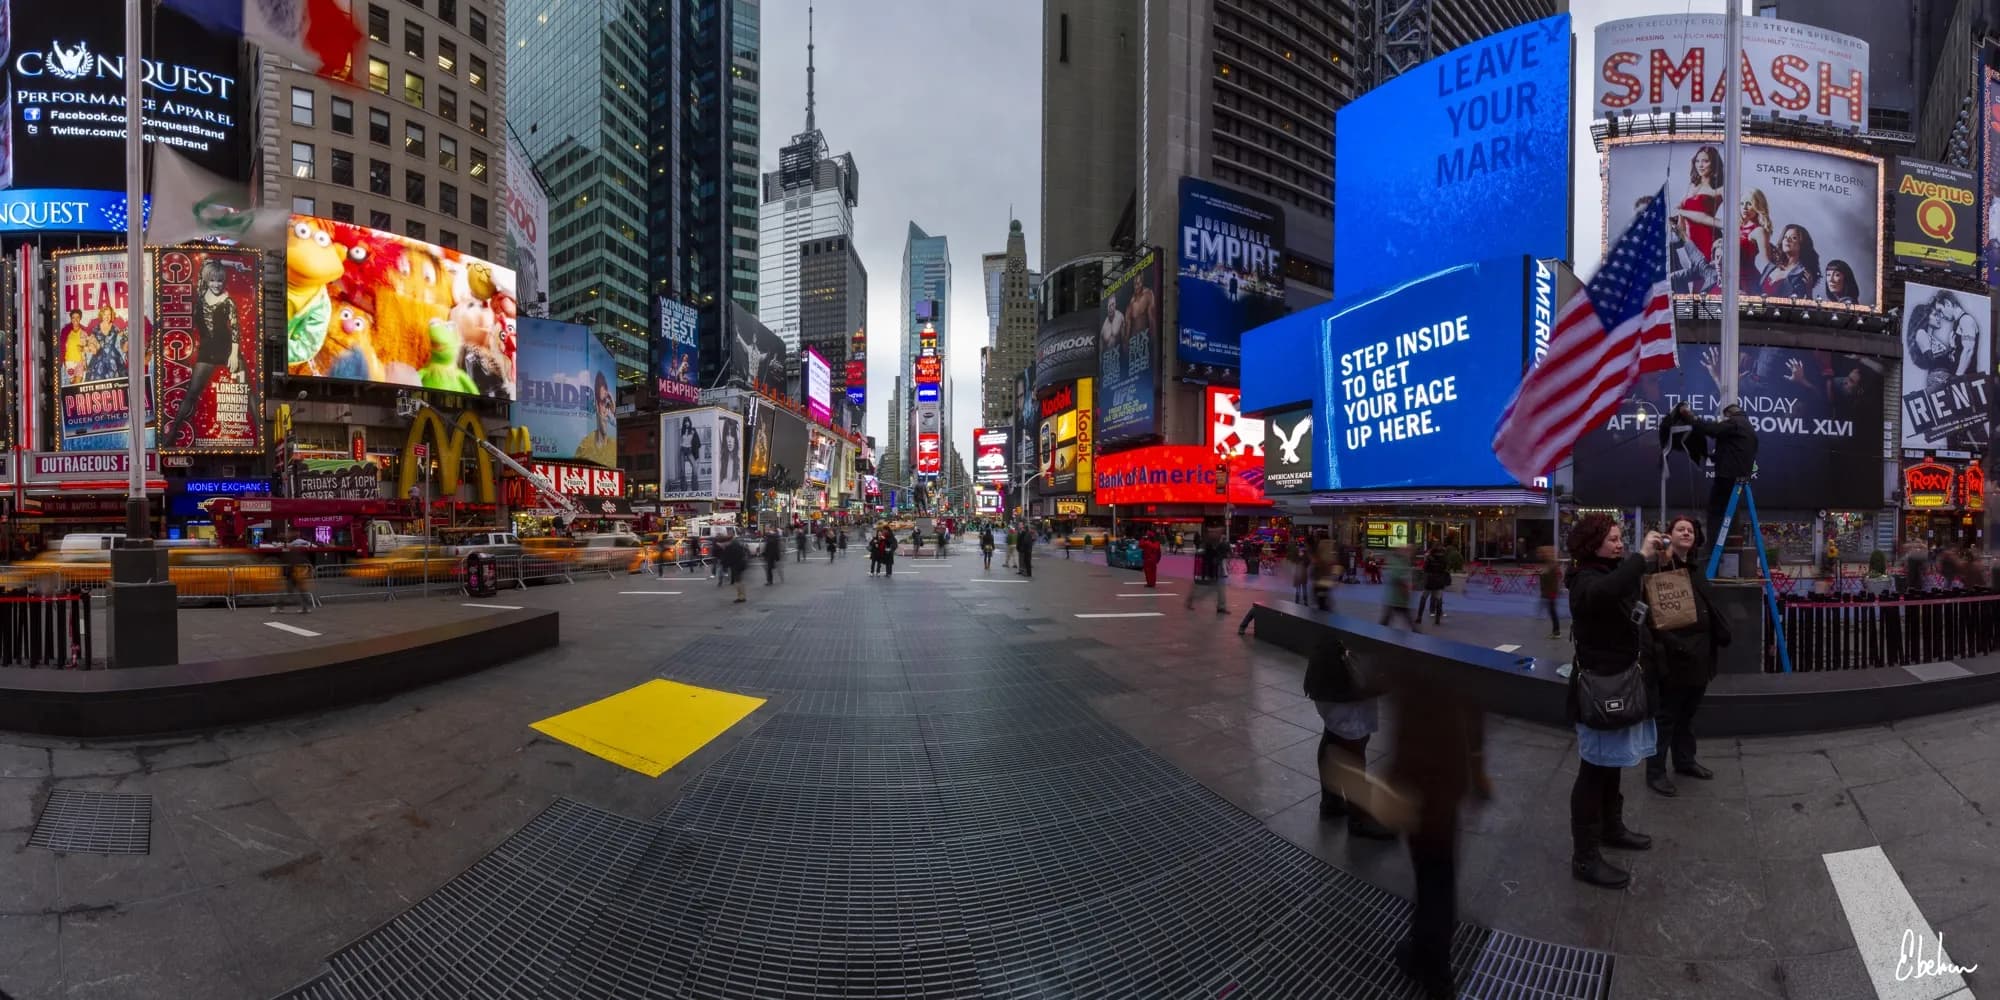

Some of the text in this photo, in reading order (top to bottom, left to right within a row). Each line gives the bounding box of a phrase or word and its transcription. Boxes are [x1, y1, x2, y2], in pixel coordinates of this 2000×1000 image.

[1638, 18, 1698, 28] EXECUTIVE
[1702, 18, 1759, 28] PROER
[1763, 22, 1804, 36] STEVEN
[1807, 31, 1864, 49] SPIELBERG
[1438, 31, 1540, 98] LEAVE
[1601, 47, 1862, 122] SMASH
[163, 101, 234, 127] APPAREL
[1447, 81, 1538, 138] YOUR
[1436, 129, 1538, 188] MARK
[1756, 163, 1867, 187] STARS AREN'T BORN.
[1772, 177, 1852, 197] THEY'RE MADE.
[1899, 174, 1974, 206] Avenue
[1195, 215, 1272, 248] BOARDWALK
[1917, 198, 1955, 243] Q
[1183, 226, 1280, 272] EMPIRE
[109, 261, 125, 270] THAT
[65, 281, 129, 313] HEAR
[661, 314, 697, 338] BEST
[661, 329, 697, 348] MUSICAL
[162, 252, 194, 449] CHICAGO
[1341, 315, 1470, 376] STEP INSIDE
[658, 378, 699, 402] MEMPHIS
[1342, 361, 1410, 400] TO GET
[65, 389, 151, 418] PRISCIL
[216, 394, 249, 404] RUNNING
[216, 403, 249, 413] AMERICAN
[1041, 386, 1072, 418] Kodak
[1344, 376, 1457, 425] YOUR FACE
[1665, 394, 1704, 411] THE
[1908, 378, 1988, 427] RENT
[67, 416, 93, 425] QUEEN
[95, 414, 104, 422] OF
[107, 412, 121, 420] THE
[216, 412, 249, 422] MUSICAL
[1607, 414, 1663, 431] AFTE
[1750, 417, 1809, 434] BOWL
[1813, 419, 1853, 437] XLVI
[1078, 409, 1090, 463] Kodak
[1346, 410, 1441, 450] UP HERE.
[41, 455, 151, 474] OUTRAGEOUS F!
[167, 457, 189, 466] FUEL
[187, 482, 219, 492] MONEY
[301, 475, 376, 492] FRIDAYS AT 10PM
[1099, 463, 1230, 489] Bank of Americ
[1267, 471, 1313, 481] AMERICAN EAGLE
[664, 490, 712, 499] DKNY JEANS
[1658, 590, 1689, 602] brown
[1660, 600, 1681, 611] bag
